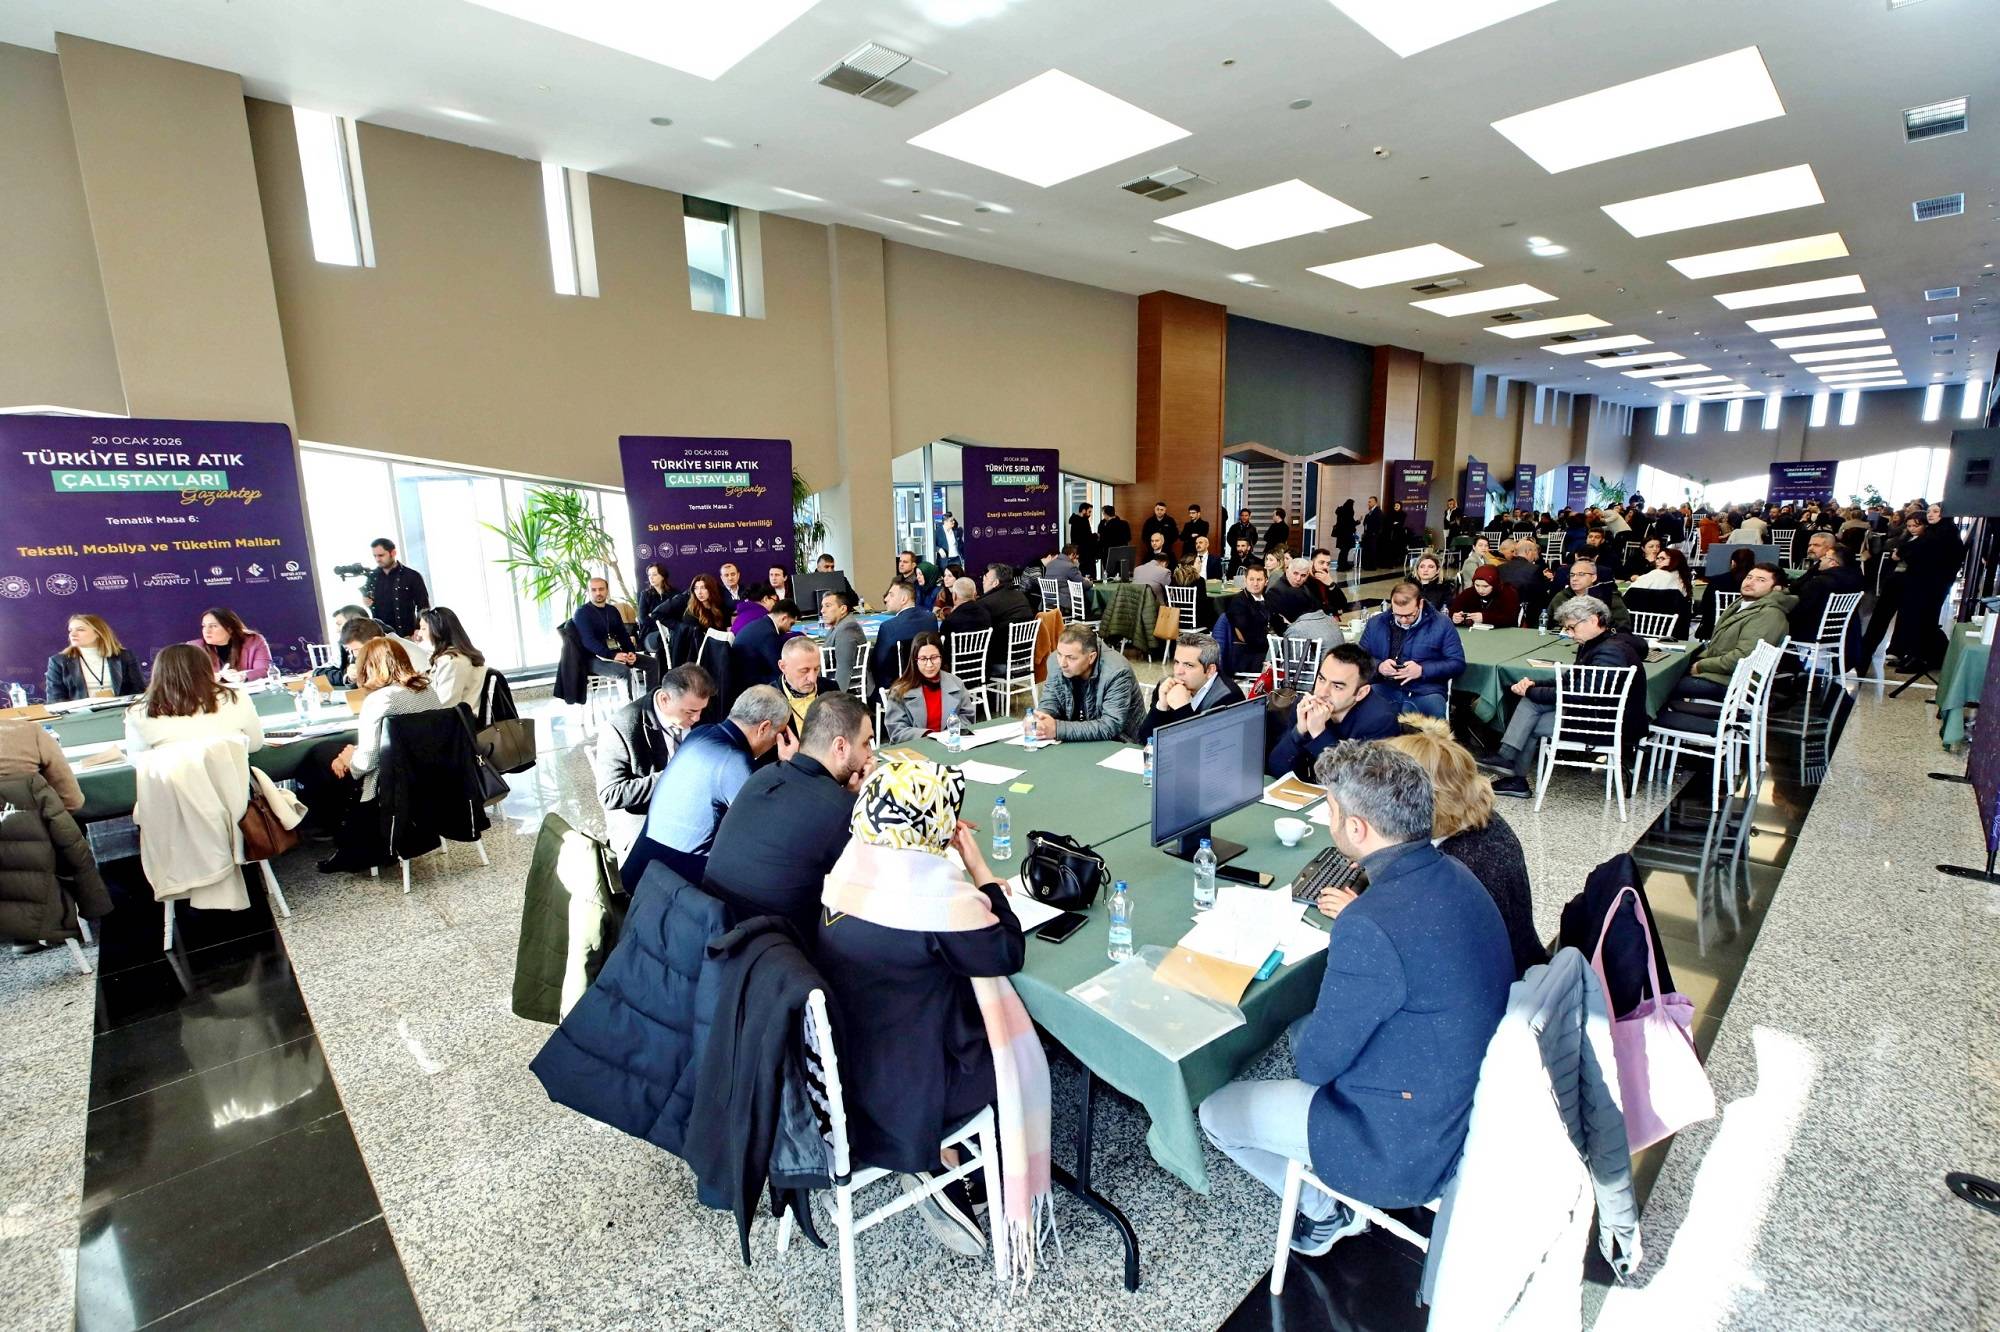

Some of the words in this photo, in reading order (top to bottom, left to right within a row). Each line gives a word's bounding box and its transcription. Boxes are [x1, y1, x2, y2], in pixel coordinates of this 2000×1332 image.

[91, 436, 108, 446] 20
[111, 436, 149, 446] OCAK
[152, 437, 182, 446] 2026
[22, 449, 129, 467] TÜRKİYE
[135, 452, 190, 466] SIFIR
[197, 453, 244, 466] ATIK
[651, 458, 701, 470] TÜRKİYE
[705, 460, 732, 470] SIFIR
[735, 460, 759, 470] ATIK
[985, 463, 1013, 472] TÜRKİYE
[1014, 465, 1030, 473] SIFIR
[61, 473, 221, 490] ÇALIŞTAYLARI
[668, 474, 746, 485] ÇALIŞTAYLARI
[993, 475, 1038, 484] ÇALIŞTAYLARI
[180, 486, 262, 506] Gaziantep
[105, 516, 153, 525] Tematik
[156, 515, 185, 525] Masa
[188, 515, 200, 524] 6:
[648, 524, 659, 532] Su
[660, 522, 695, 531] Yönetimi
[708, 521, 735, 529] Sulama
[736, 519, 773, 528] Verimliliği
[16, 544, 79, 557] Tekstil,
[83, 541, 146, 557] Mobilya
[150, 542, 169, 552] ve
[173, 538, 230, 551] Tüketim
[235, 537, 281, 548] Malları
